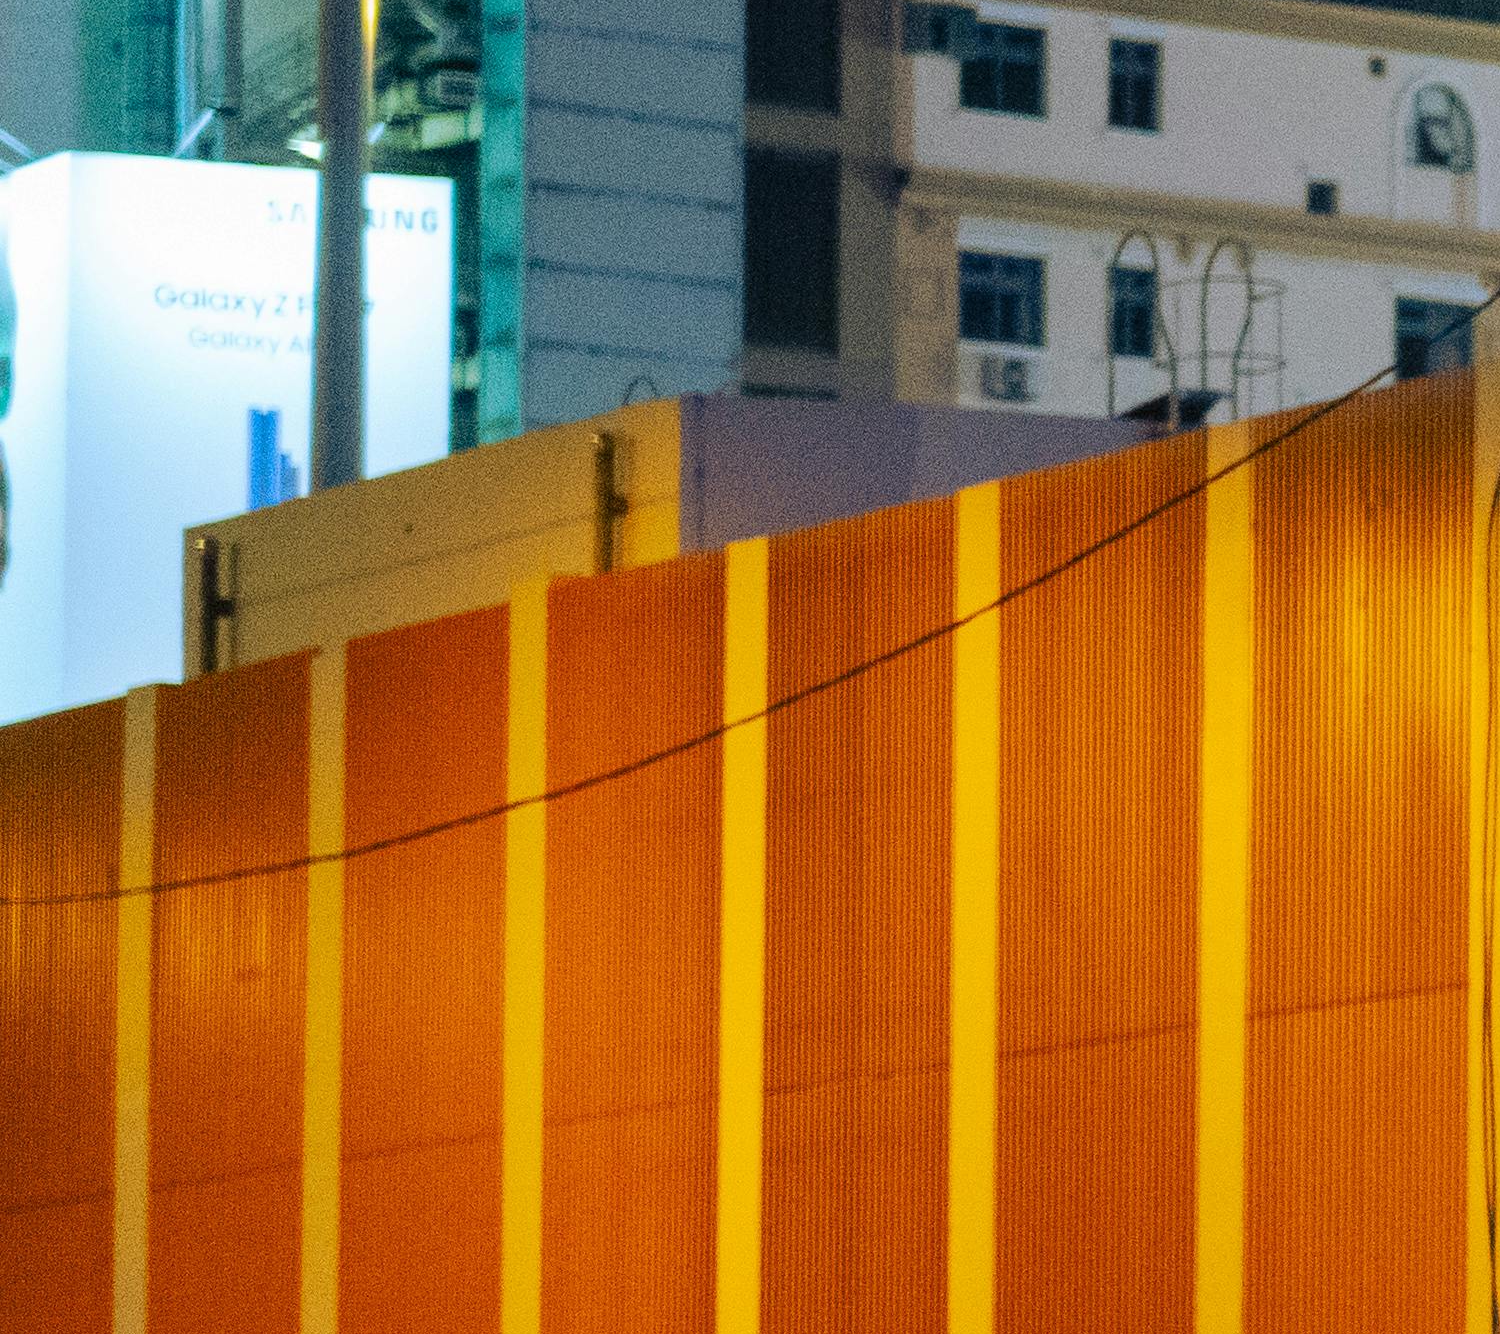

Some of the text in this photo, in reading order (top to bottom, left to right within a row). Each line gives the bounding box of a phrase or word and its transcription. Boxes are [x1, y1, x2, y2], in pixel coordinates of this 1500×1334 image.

[266, 199, 439, 234] SAUNG
[154, 284, 265, 319] Galaxy
[274, 293, 288, 316] Z
[189, 328, 281, 356] Galaxy
